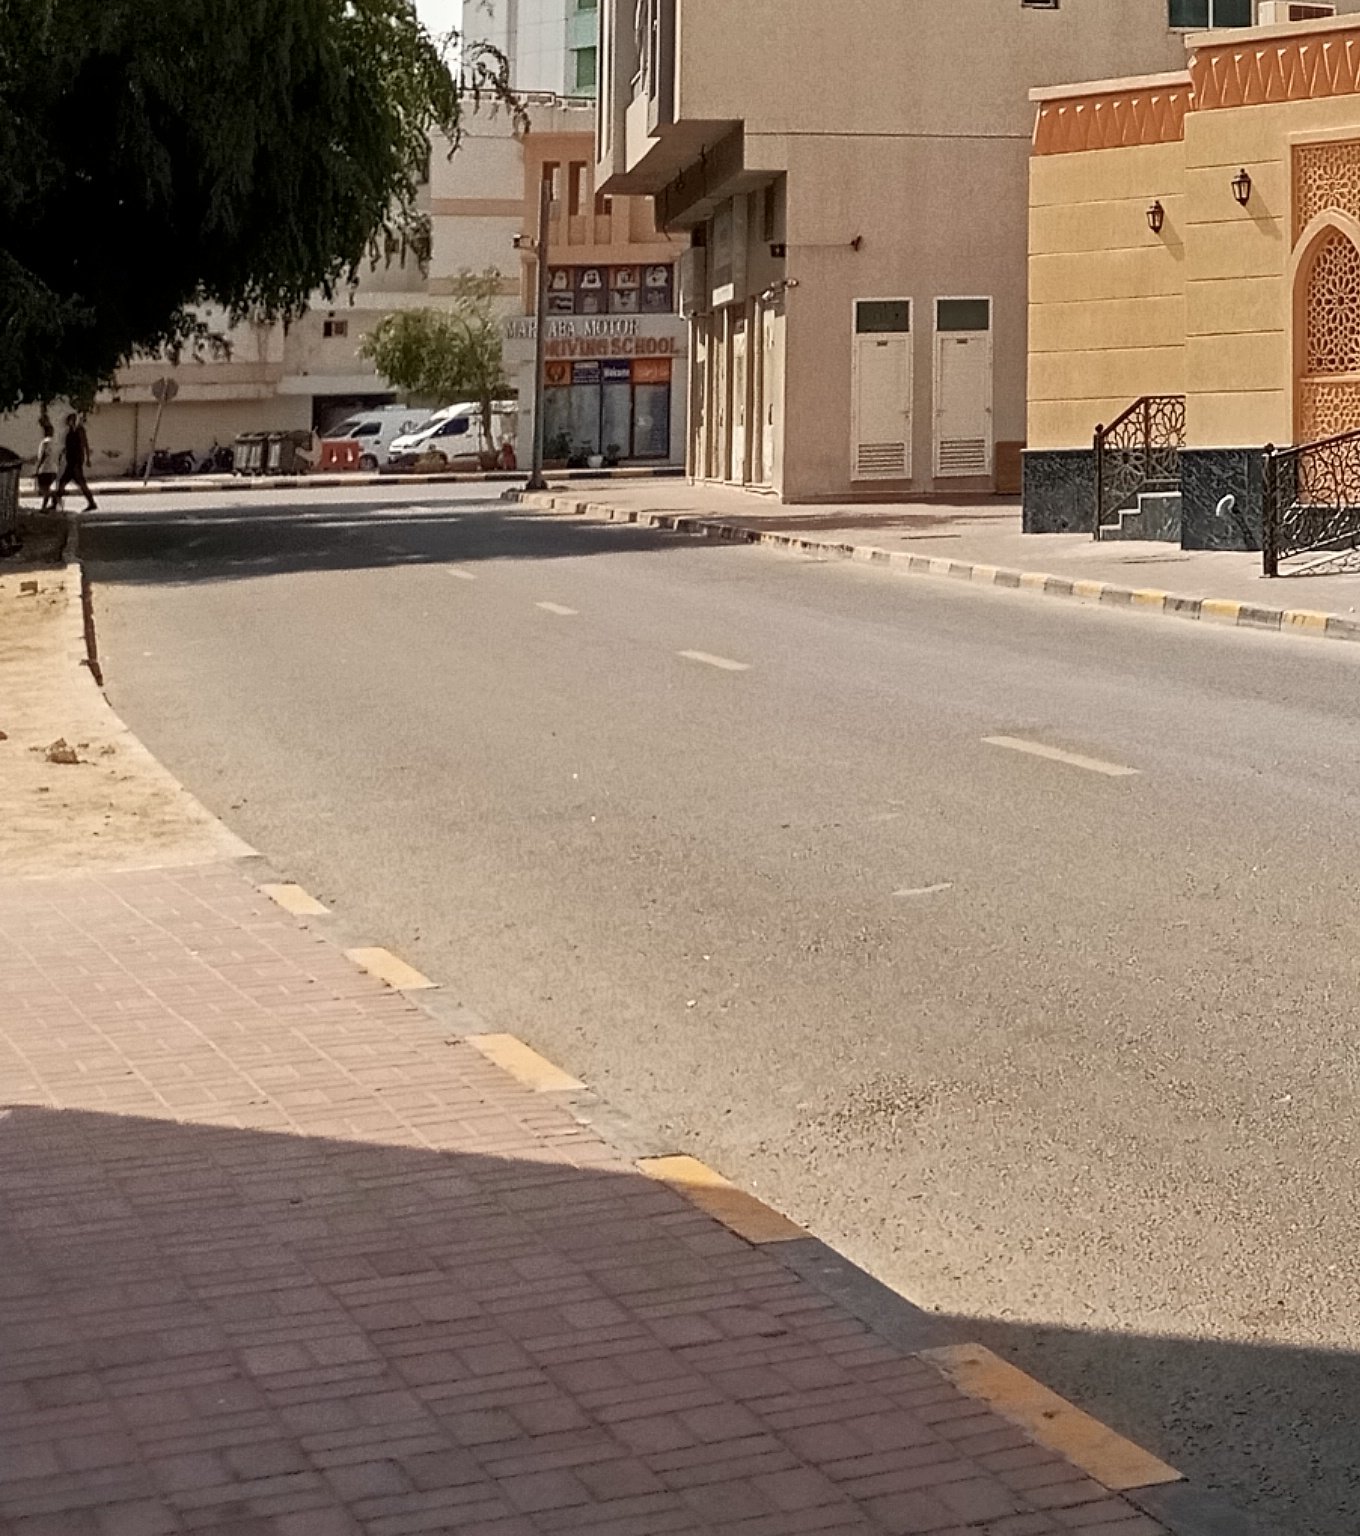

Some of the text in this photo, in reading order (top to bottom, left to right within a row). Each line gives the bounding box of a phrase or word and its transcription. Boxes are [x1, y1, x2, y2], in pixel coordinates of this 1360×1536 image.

[507, 319, 639, 339] MARABA MOTOR
[611, 337, 679, 354] SCHOOL
